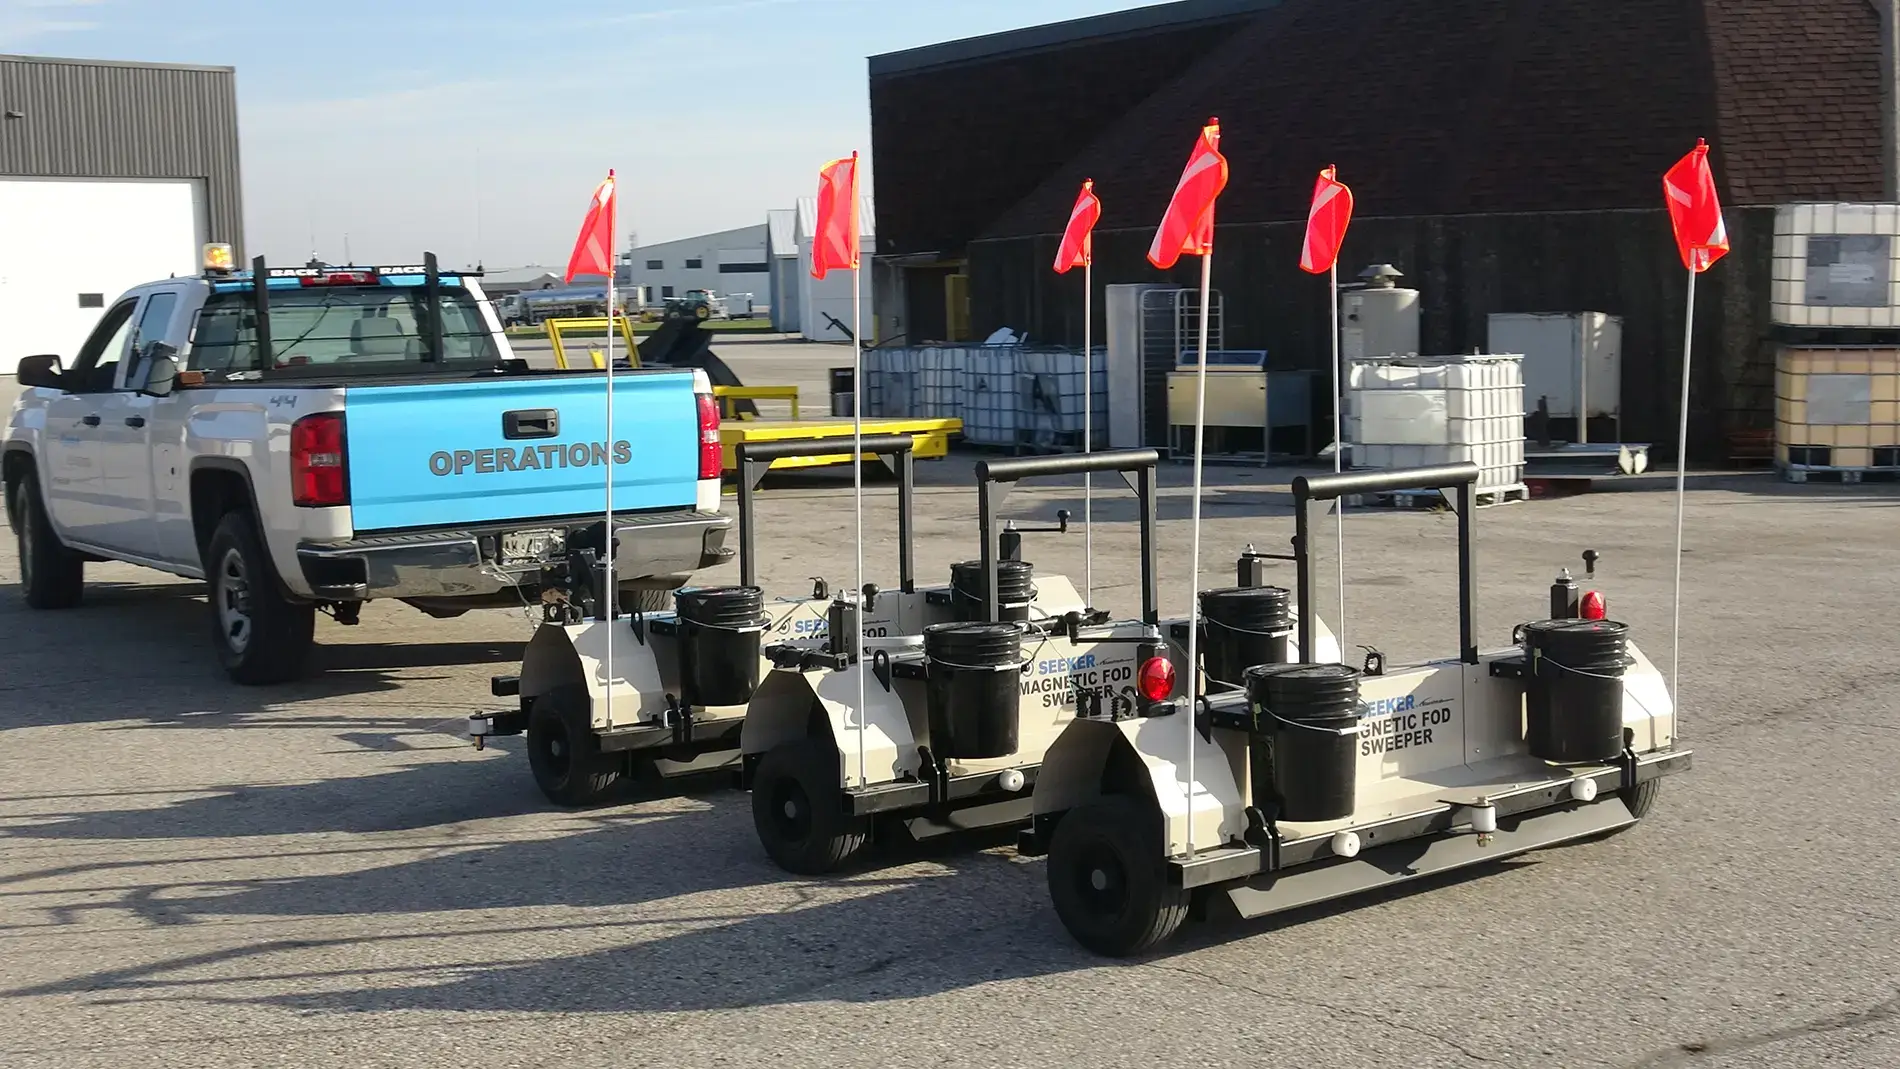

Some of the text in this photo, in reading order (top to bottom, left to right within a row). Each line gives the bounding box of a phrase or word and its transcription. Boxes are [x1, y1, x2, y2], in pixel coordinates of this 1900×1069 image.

[270, 266, 426, 277] BACK RACK
[429, 440, 632, 476] OPERATIONS
[1038, 654, 1096, 675] SEEKER
[1019, 666, 1132, 695] MAGNETIC FOD
[1361, 695, 1416, 718] EEKER
[1357, 708, 1451, 739] GNETIC FOD
[1361, 729, 1433, 756] SWEEPER
